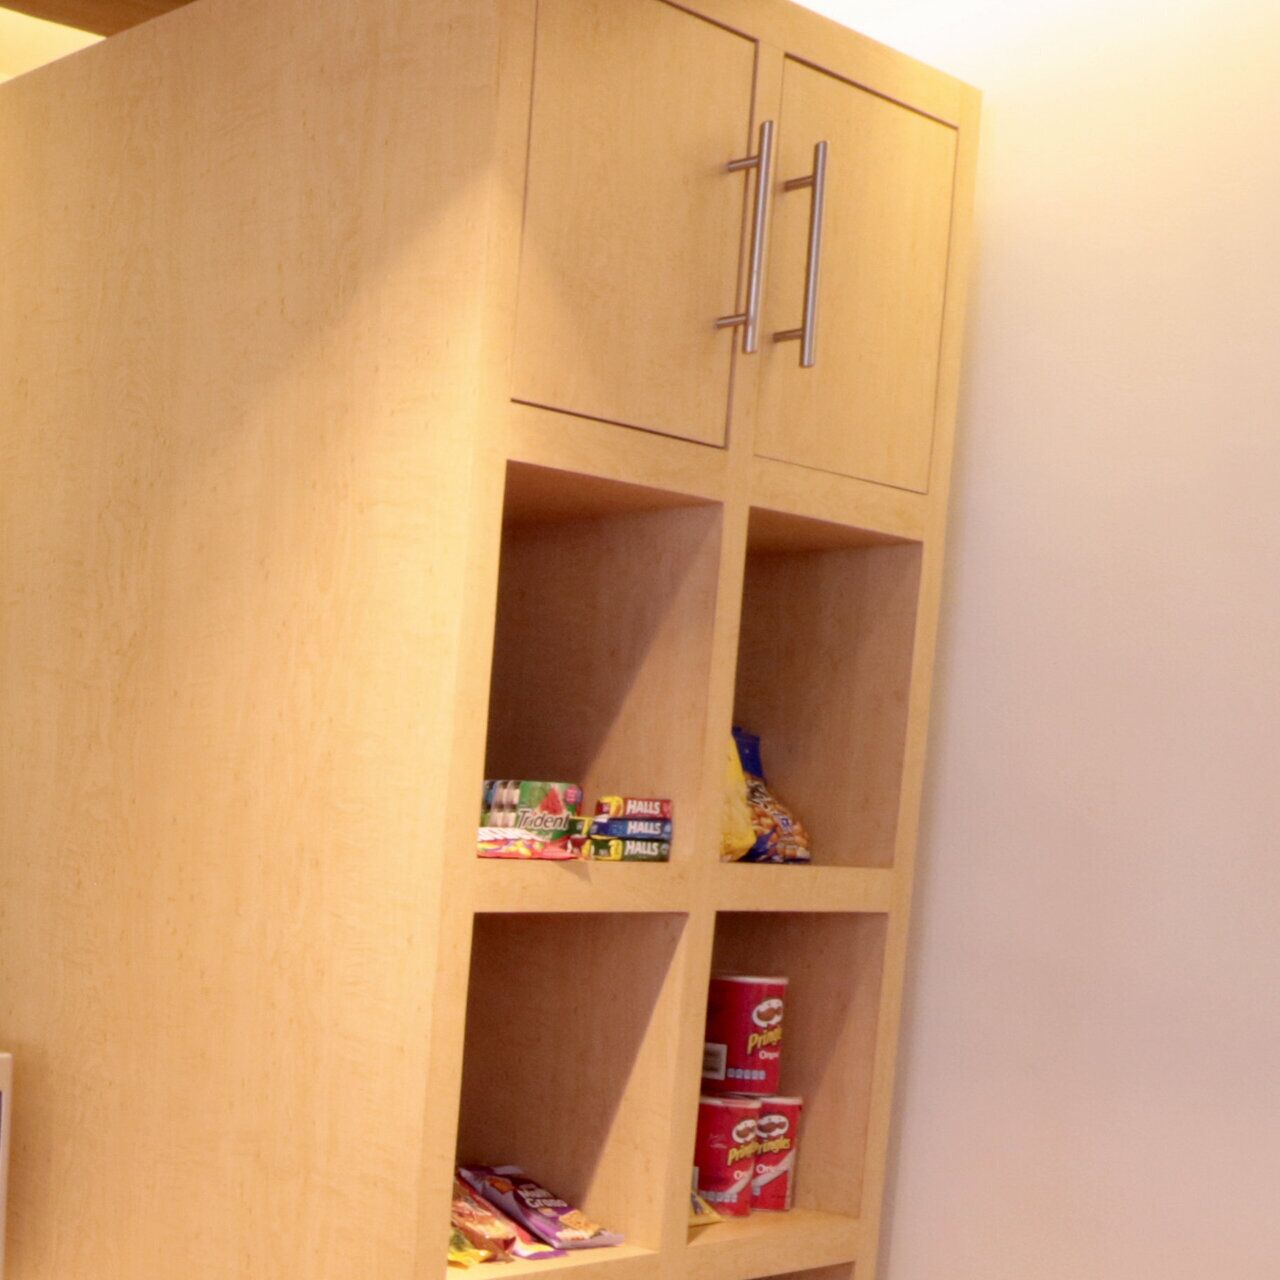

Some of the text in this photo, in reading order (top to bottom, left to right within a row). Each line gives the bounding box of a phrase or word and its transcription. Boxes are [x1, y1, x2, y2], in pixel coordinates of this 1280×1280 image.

[626, 799, 661, 816] HALLS
[517, 808, 571, 830] Trident
[626, 821, 662, 835] HALLS
[624, 839, 659, 856] HALLS
